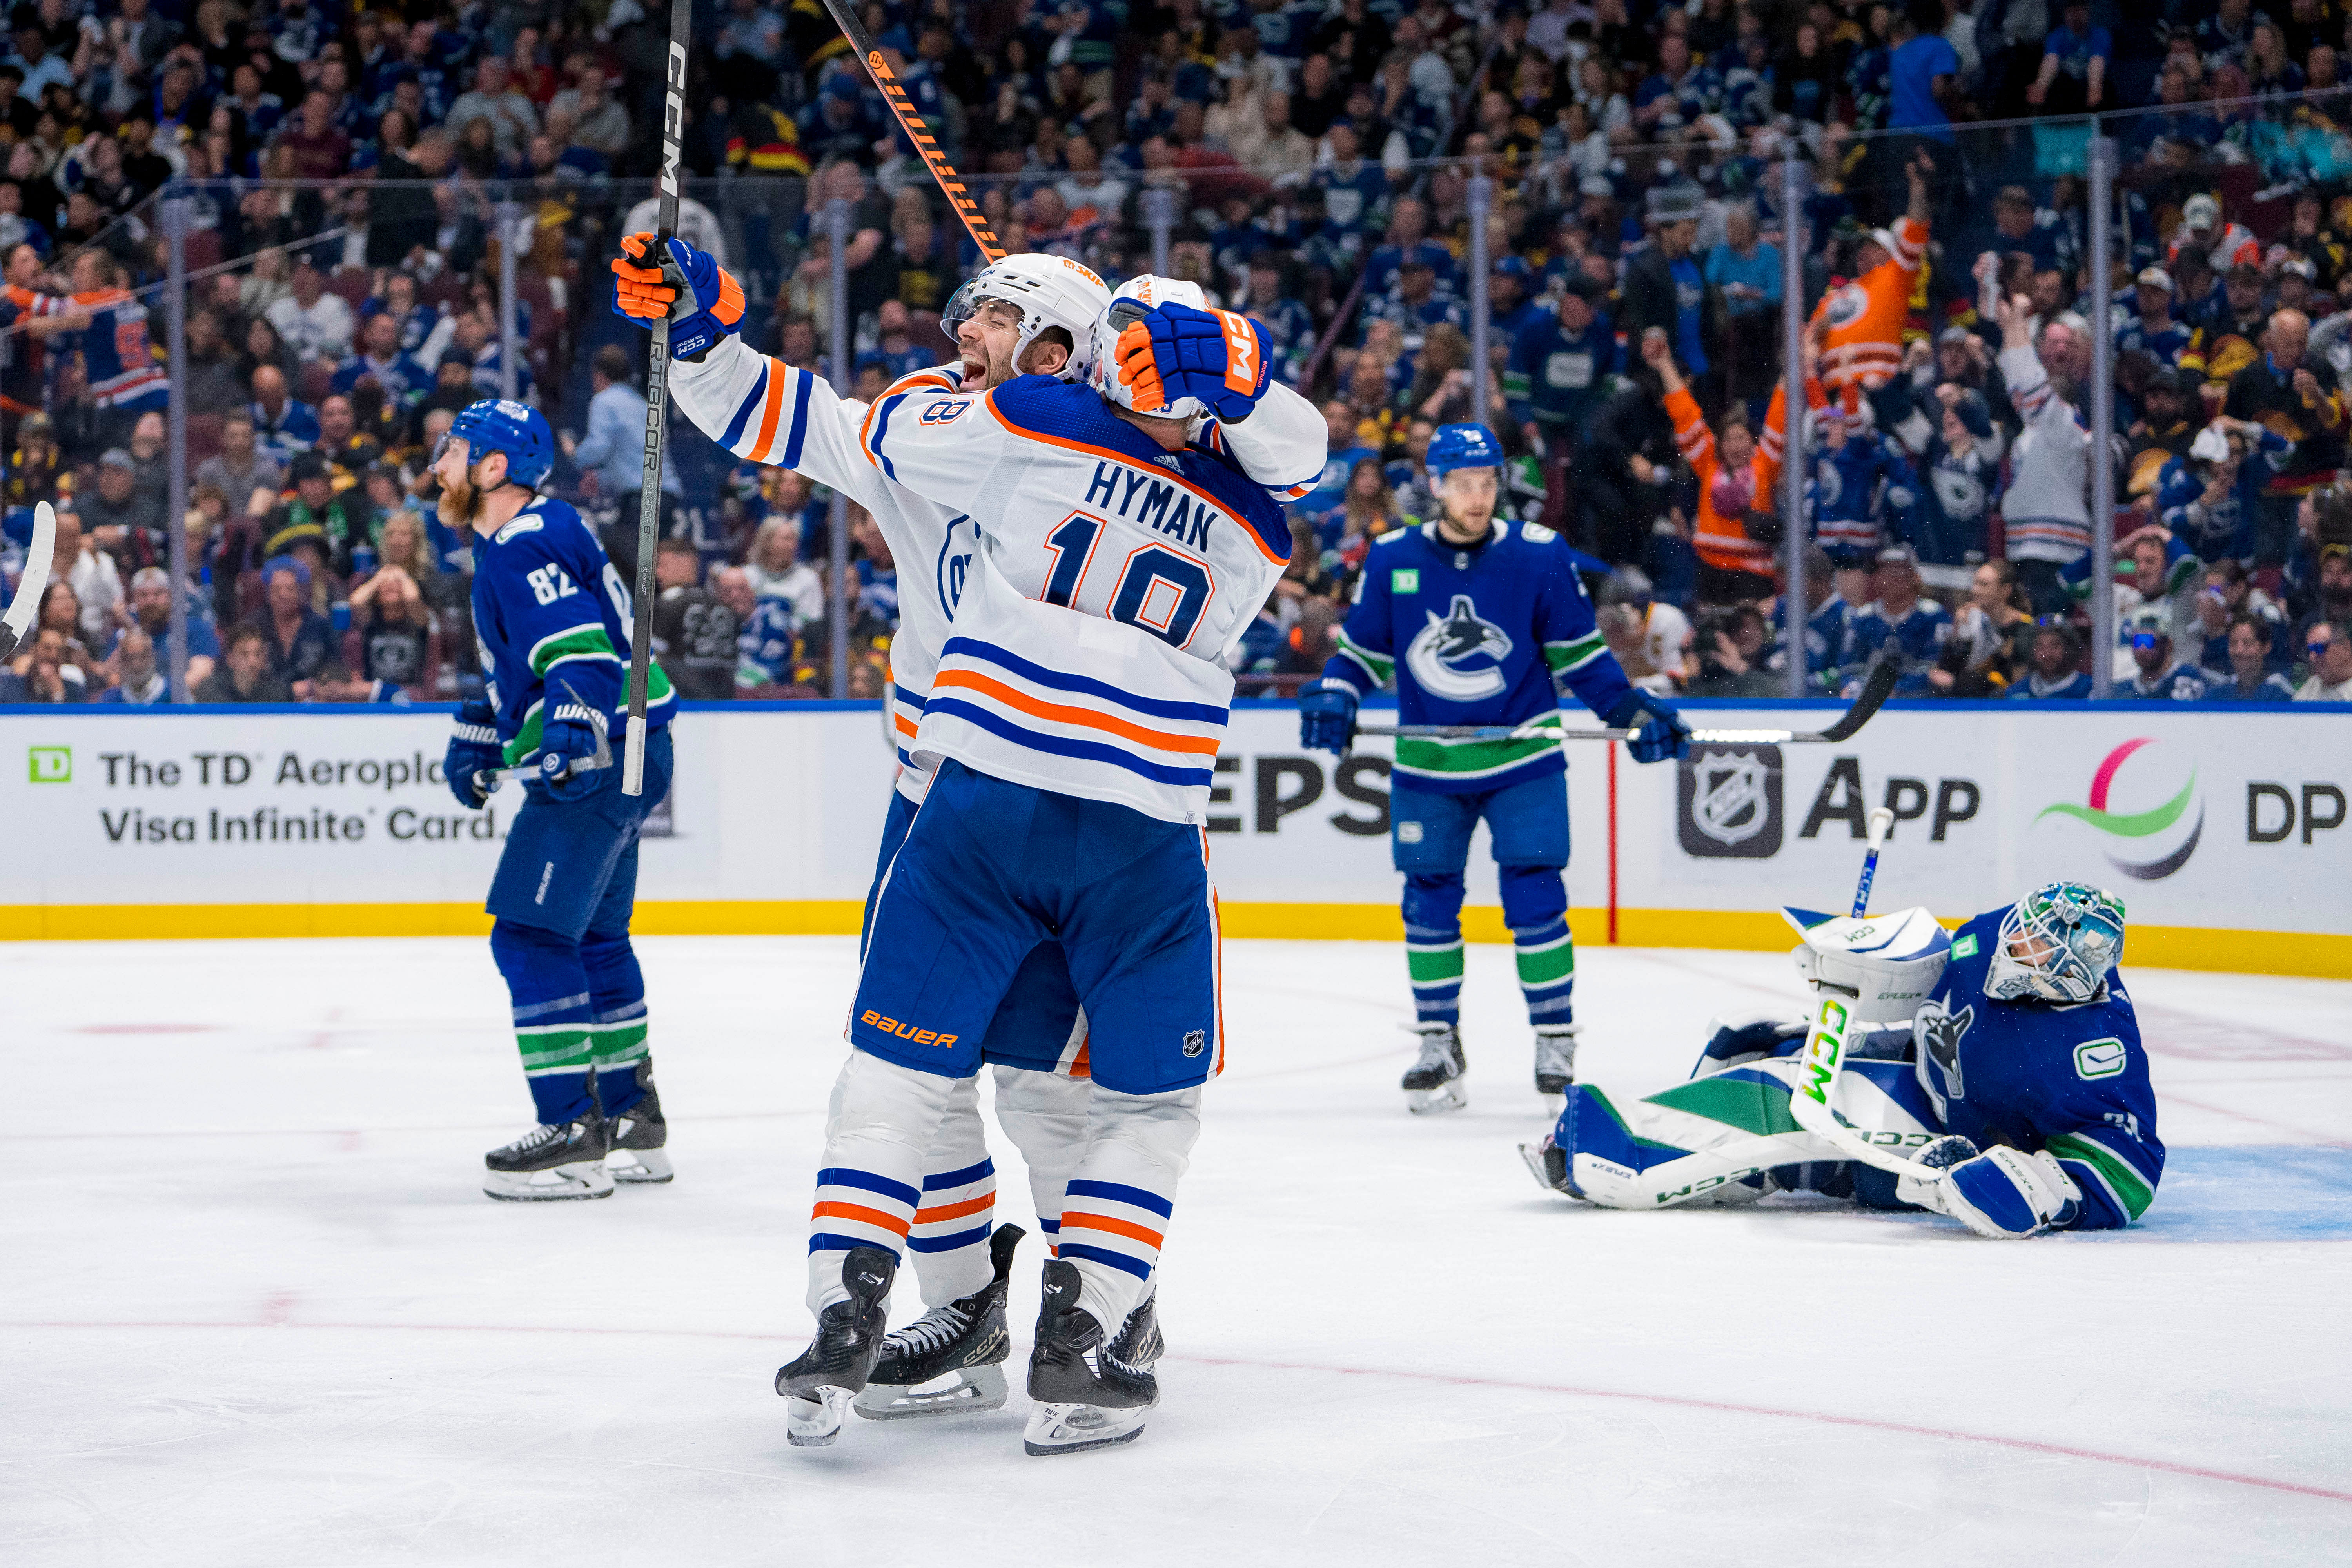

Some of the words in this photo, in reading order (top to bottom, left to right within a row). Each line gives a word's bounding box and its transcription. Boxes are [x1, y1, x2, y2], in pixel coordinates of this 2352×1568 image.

[661, 40, 686, 197] CCM
[1076, 265, 1104, 288] SKIP
[678, 338, 705, 356] CCM
[1019, 323, 1033, 336] BAUER
[1256, 360, 1267, 387] BOUCHARD
[644, 341, 664, 472] RIBCOR
[1153, 455, 1185, 475] adidas
[644, 476, 653, 524] TRIGGER
[1084, 461, 1218, 554] HYMAN
[526, 562, 579, 606] 82
[33, 748, 71, 779] TD
[98, 751, 182, 786] The
[191, 752, 252, 785] TD
[98, 808, 195, 842] Visa
[209, 806, 366, 842] Infinite
[2247, 781, 2347, 844] DP
[1845, 925, 1875, 942] CCM
[860, 1009, 958, 1049] BAUER
[1187, 1036, 1201, 1053] NHL
[1799, 1000, 1847, 1105] CCM
[1657, 1167, 1759, 1204] CCM
[2045, 1159, 2069, 1185] CCM
[963, 1324, 1000, 1365] CCM
